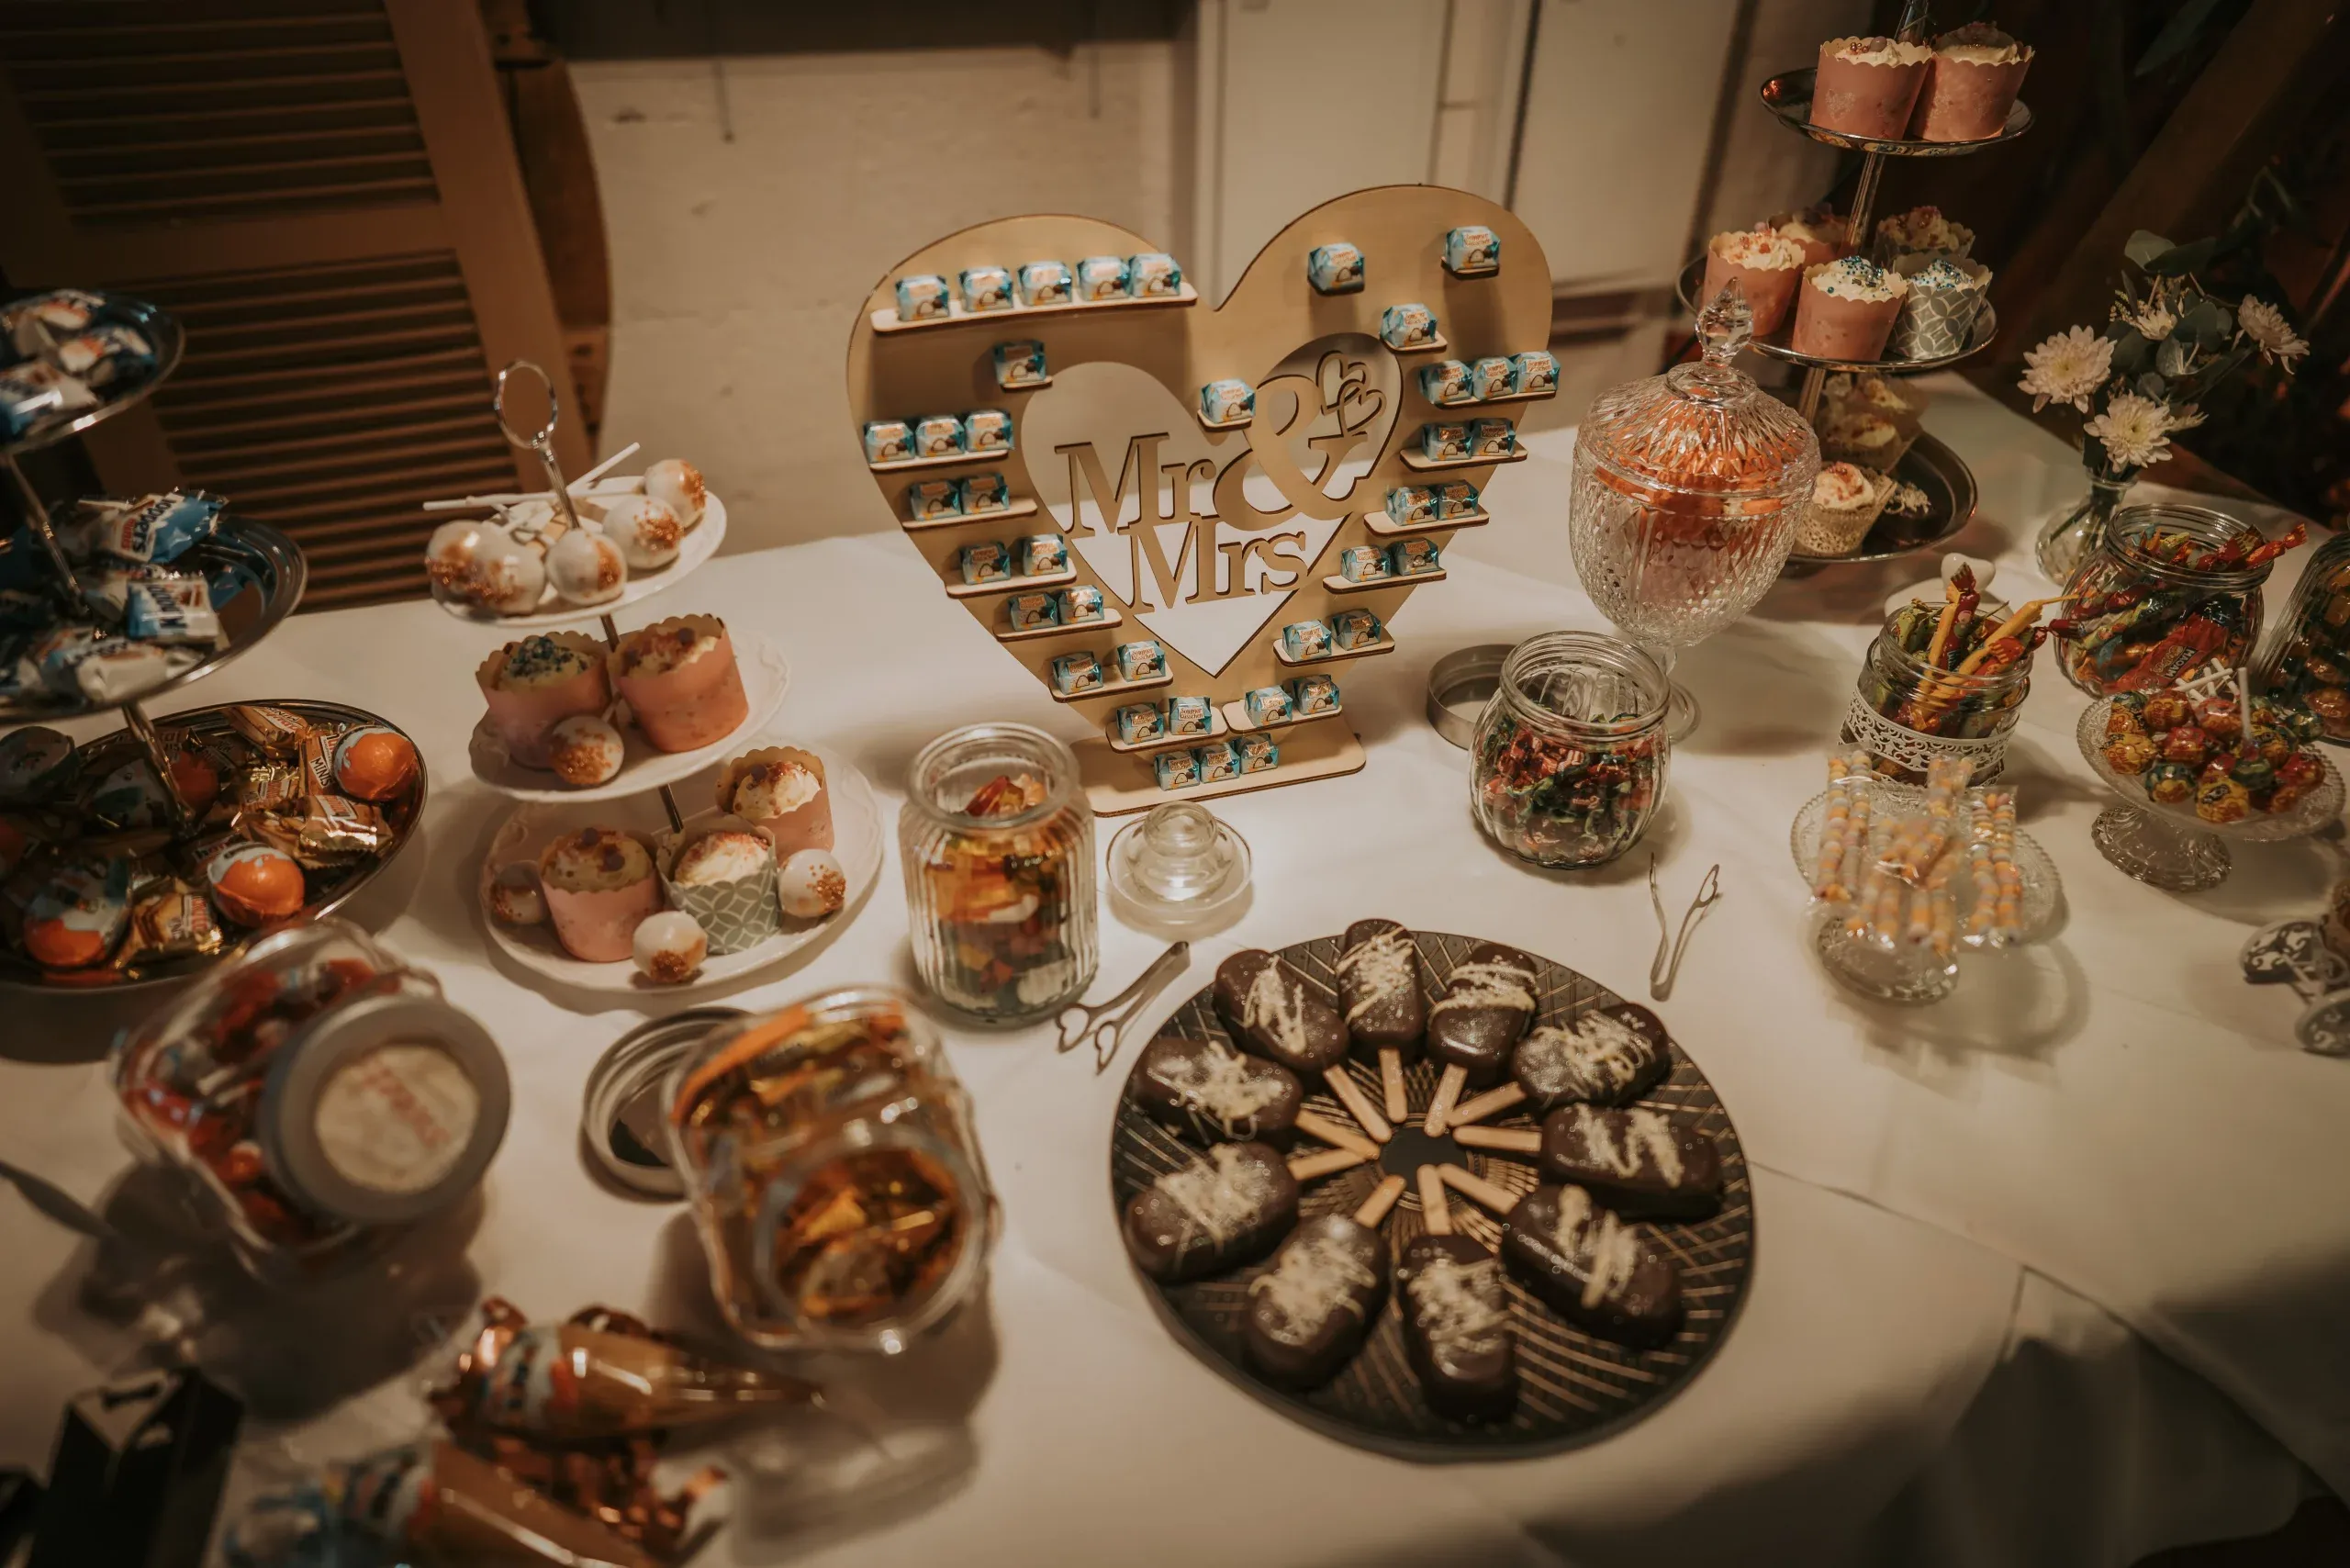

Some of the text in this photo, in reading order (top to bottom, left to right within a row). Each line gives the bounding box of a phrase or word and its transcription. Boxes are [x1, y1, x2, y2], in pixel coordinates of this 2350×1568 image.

[1054, 431, 1217, 537] Mr
[1117, 514, 1307, 613] Mrs
[2165, 646, 2196, 678] MAOAM
[309, 756, 332, 788] MINIS
